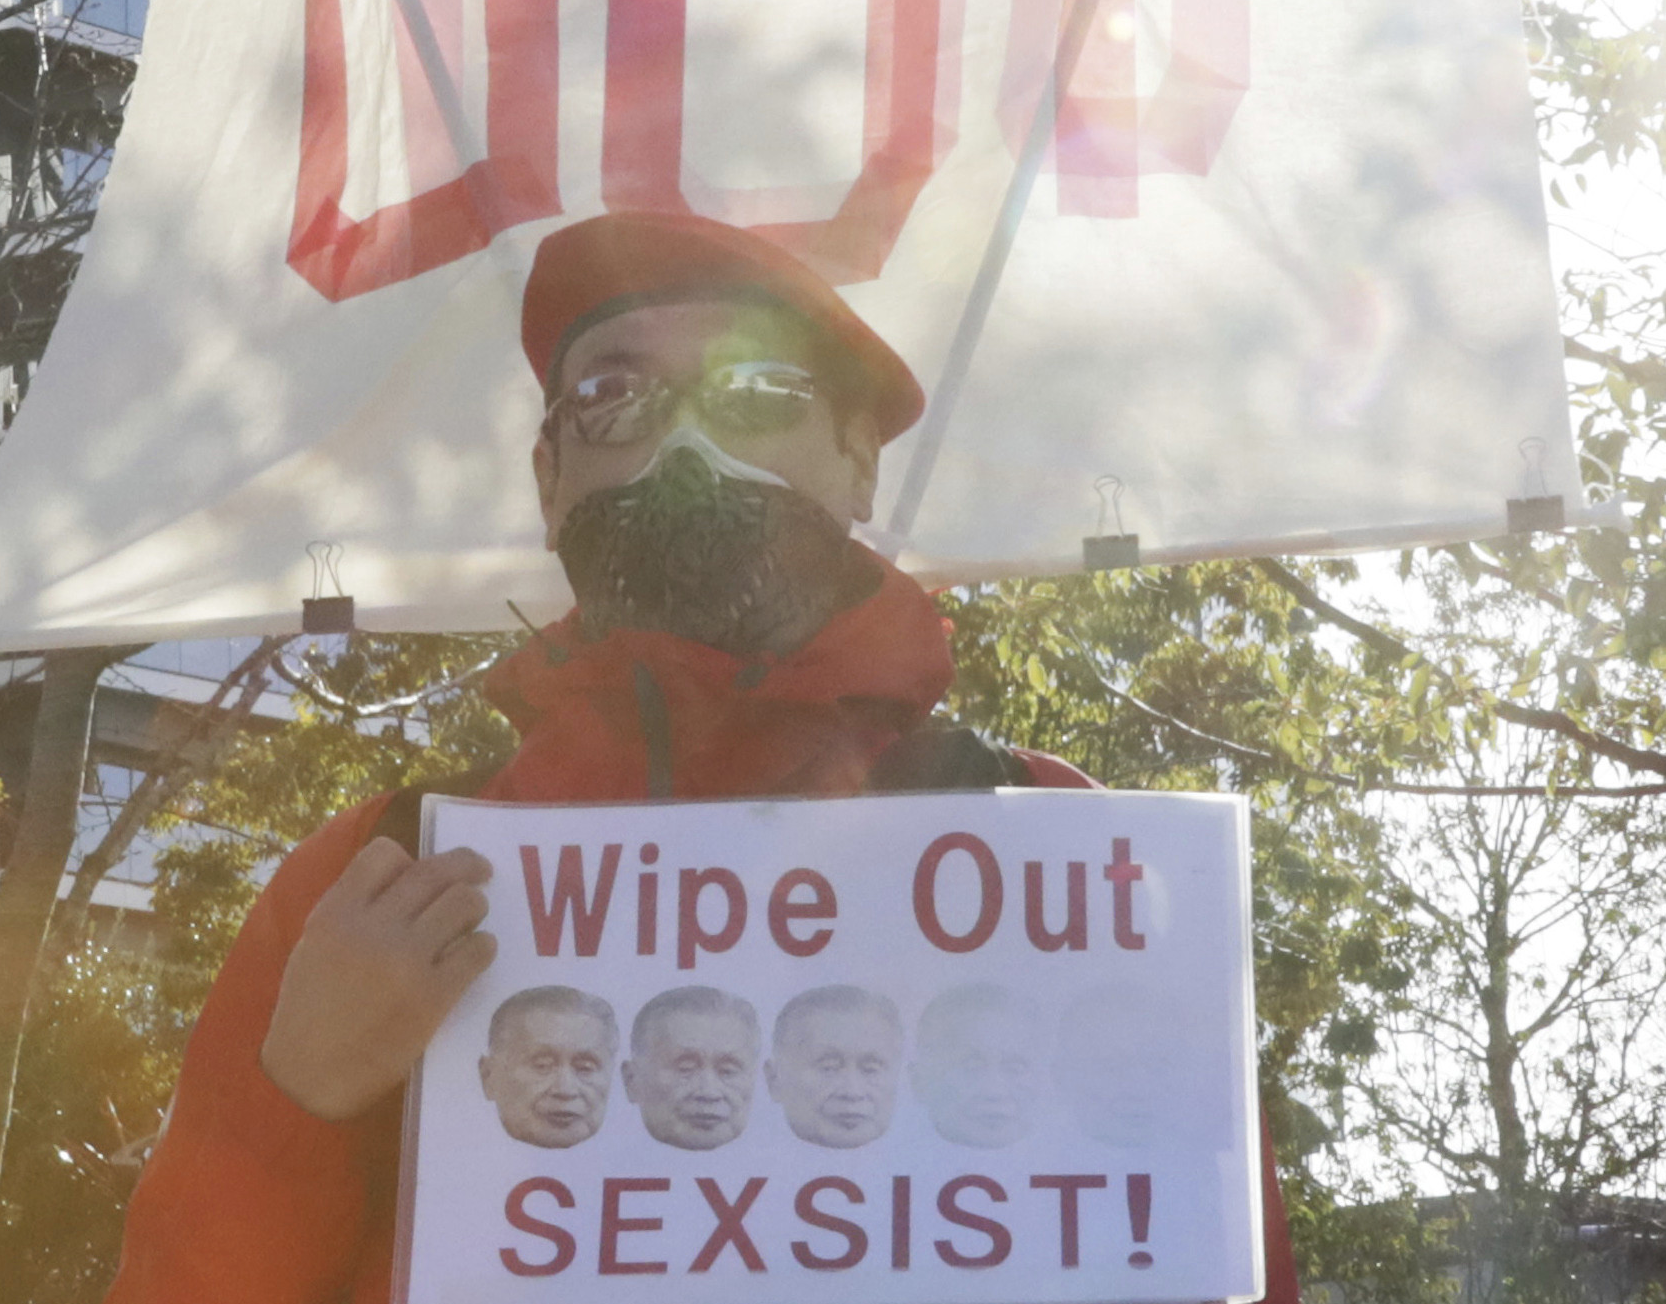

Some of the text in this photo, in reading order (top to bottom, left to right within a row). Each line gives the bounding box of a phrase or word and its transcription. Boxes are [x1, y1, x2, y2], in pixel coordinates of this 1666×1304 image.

[518, 831, 1146, 970] Wipe Out
[497, 1171, 1155, 1278] SEXSIST!
